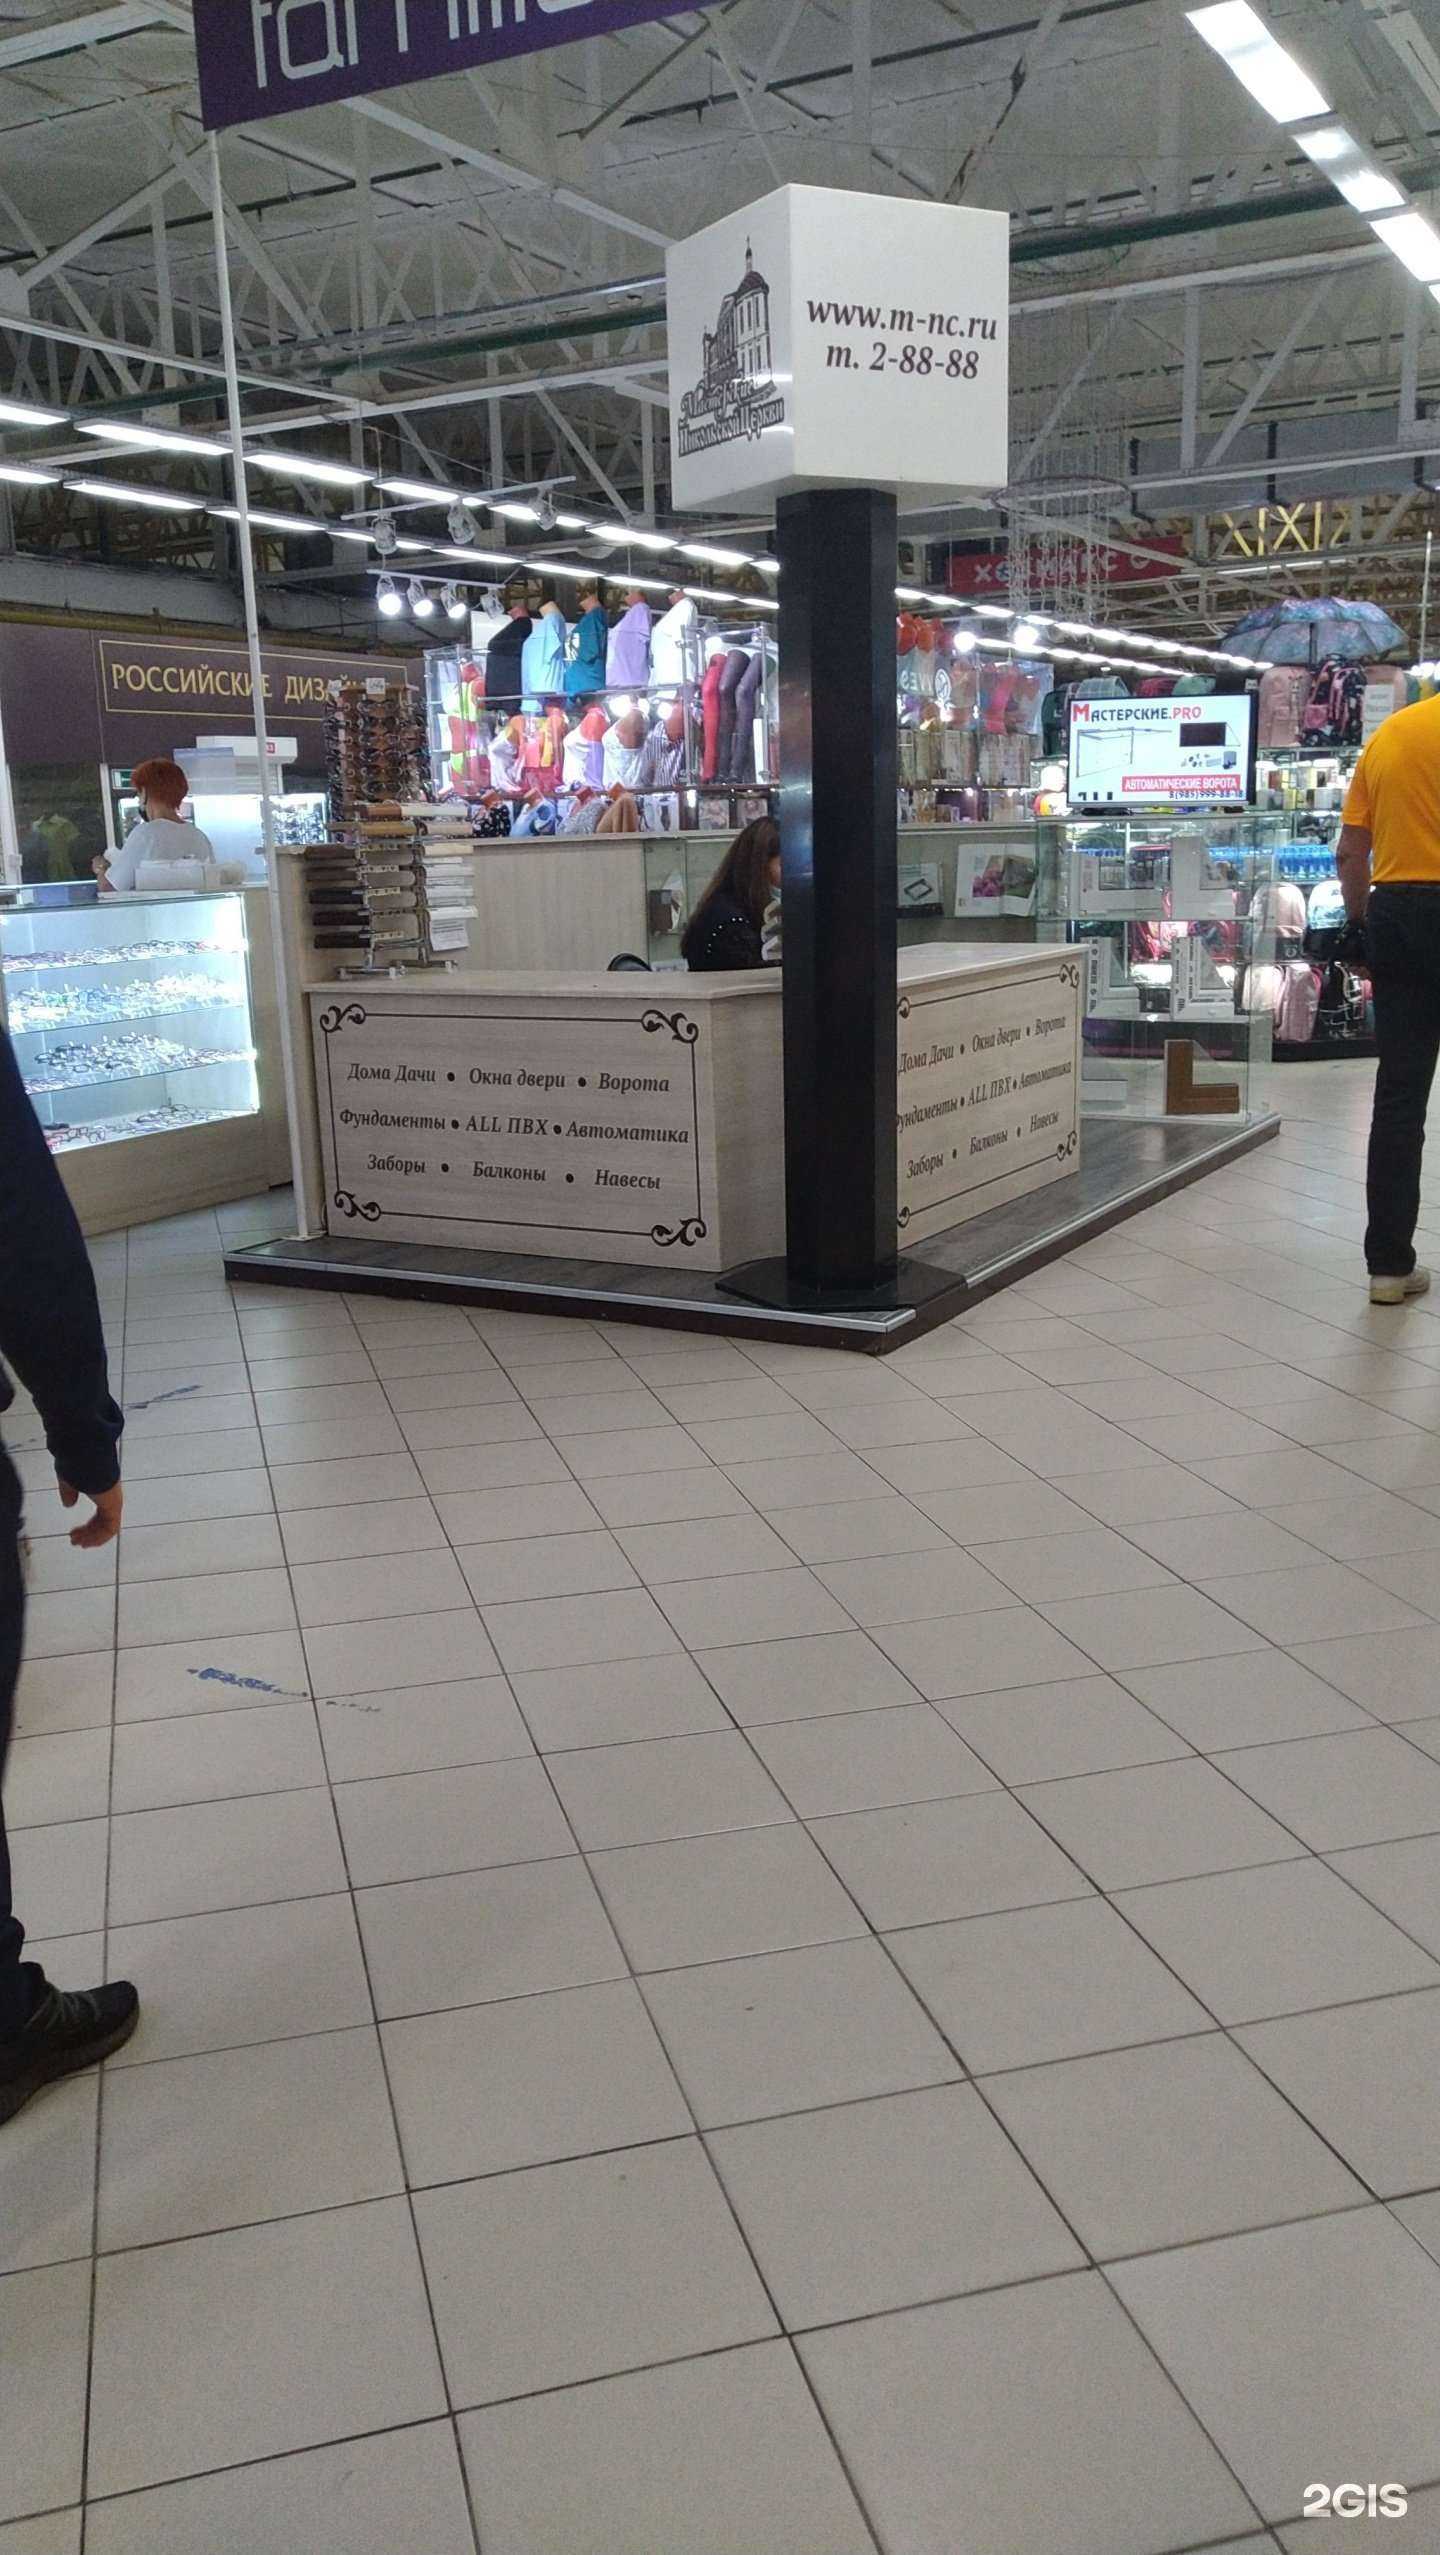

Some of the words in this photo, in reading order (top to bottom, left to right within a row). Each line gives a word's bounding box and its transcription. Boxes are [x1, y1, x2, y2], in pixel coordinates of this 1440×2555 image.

[806, 300, 997, 341] www.m-nc.ru
[868, 341, 979, 380] 2-88-88
[1124, 777, 1201, 791] АВТОМАТИЧЕСКИЕ
[1202, 776, 1238, 790] ВОРОТА
[899, 1053, 927, 1074] Дома
[929, 1045, 954, 1065] Дачи
[972, 1034, 995, 1052] Окна
[996, 1027, 1021, 1047] двери
[1035, 1017, 1066, 1036] Ворота
[347, 1063, 391, 1082] Дома
[394, 1065, 437, 1083] Дачи
[468, 1068, 513, 1086] Окна
[516, 1068, 566, 1089] двери
[598, 1072, 670, 1094] Ворота
[967, 1083, 988, 1106] ALL
[990, 1075, 1012, 1098] ПВХ
[1018, 1061, 1072, 1089] Автоматика
[339, 1108, 446, 1131] Фундаменты
[465, 1115, 502, 1133] ALL
[507, 1117, 549, 1136] ПВХ
[565, 1121, 690, 1144] Автоматика
[906, 1153, 944, 1178] Заборы
[970, 1129, 1008, 1155] Балконы
[1029, 1111, 1060, 1133] Навесы
[367, 1154, 426, 1175] Заборы
[472, 1160, 546, 1183] Балконы
[594, 1169, 661, 1190] Навесы
